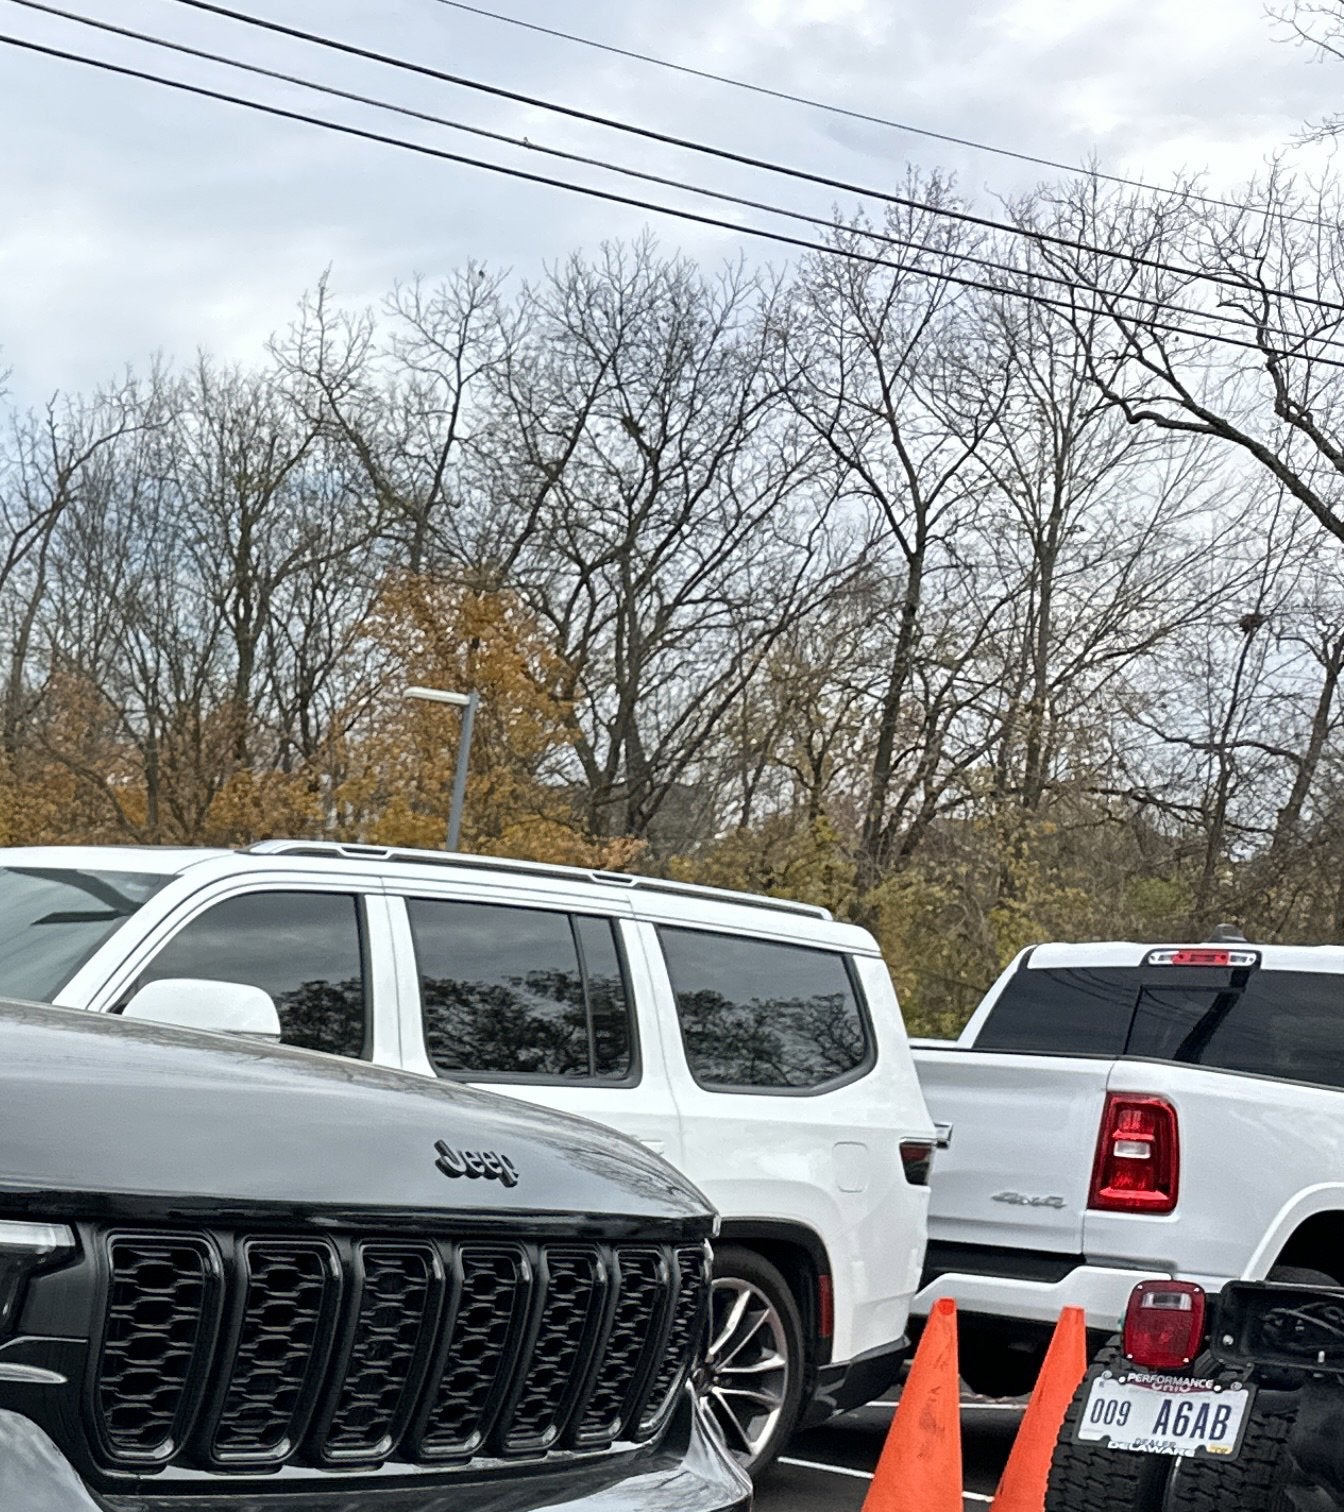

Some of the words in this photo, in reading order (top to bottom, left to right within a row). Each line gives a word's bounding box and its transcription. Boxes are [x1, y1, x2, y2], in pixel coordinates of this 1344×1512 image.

[433, 1139, 520, 1188] Jeep
[1126, 1372, 1215, 1390] PERFORMANCE
[1090, 1398, 1132, 1427] 009
[1152, 1398, 1233, 1441] A6AB
[1107, 1440, 1196, 1458] DELAWARE
